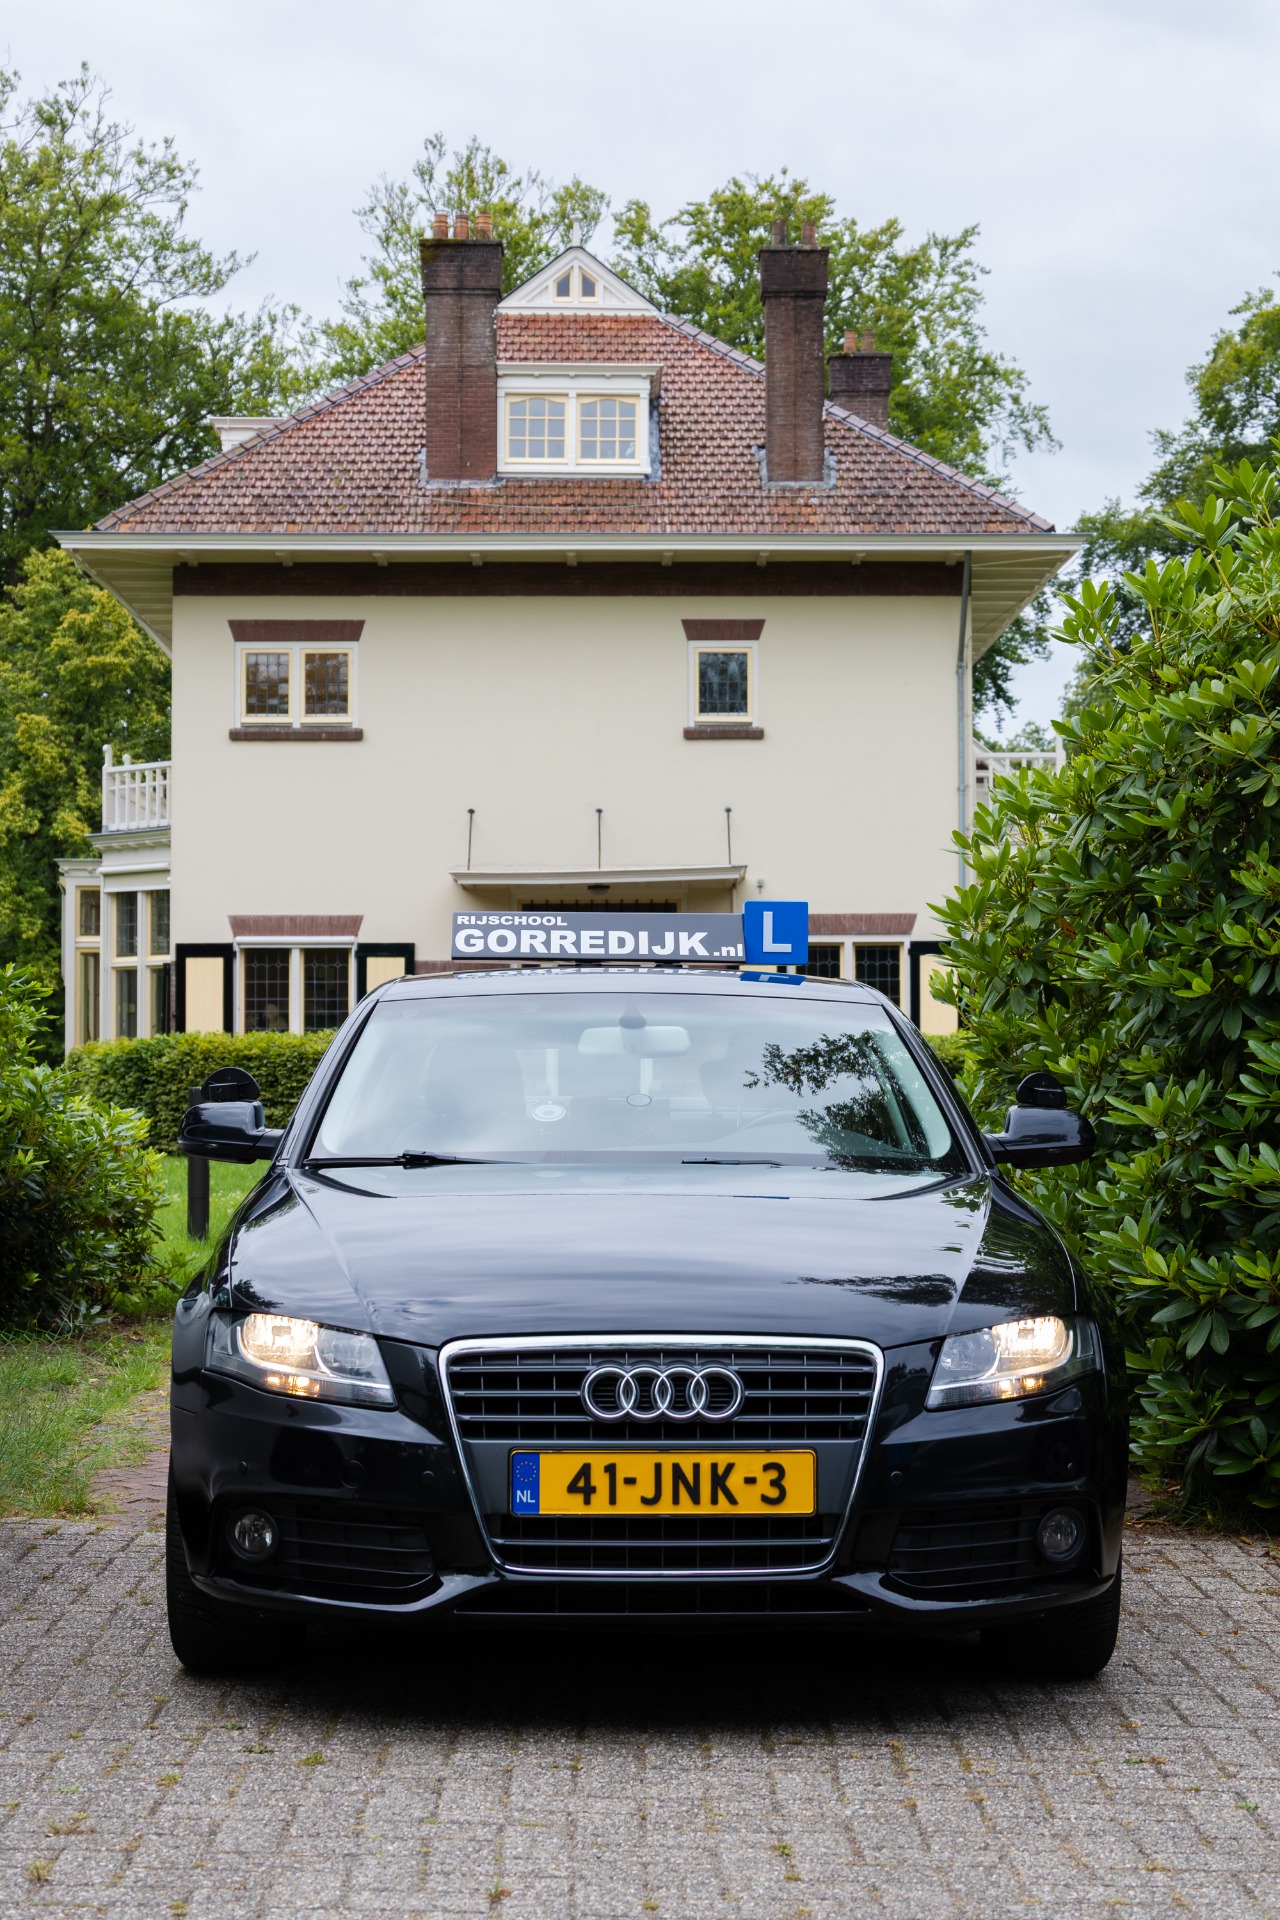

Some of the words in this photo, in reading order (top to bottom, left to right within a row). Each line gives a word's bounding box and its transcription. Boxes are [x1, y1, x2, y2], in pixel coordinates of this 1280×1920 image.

[457, 915, 568, 926] RIJSCHOOL
[762, 911, 792, 953] L
[454, 928, 744, 957] GORREDIJK.nl
[516, 1490, 536, 1503] NL
[566, 1461, 787, 1506] 41-JNK-3
